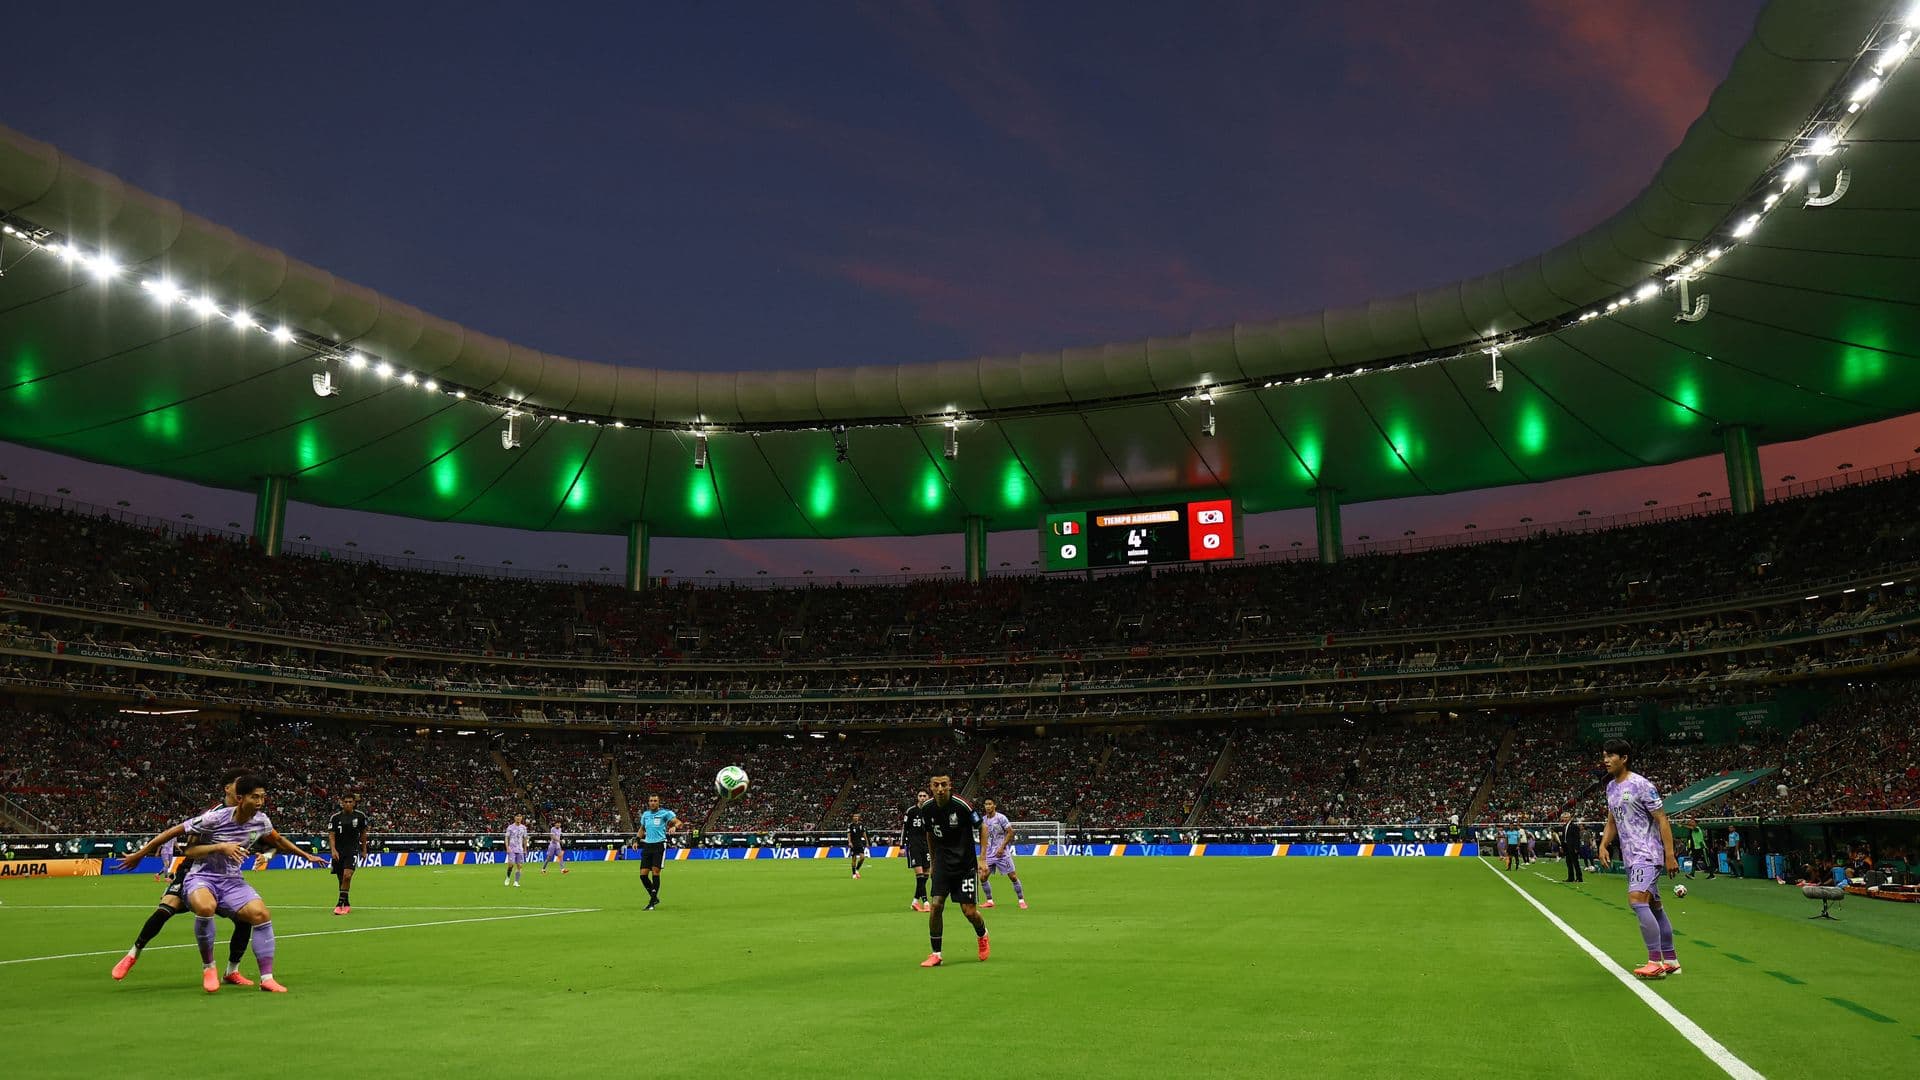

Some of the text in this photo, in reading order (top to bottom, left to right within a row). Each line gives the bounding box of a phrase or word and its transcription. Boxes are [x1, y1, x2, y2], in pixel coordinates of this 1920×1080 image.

[1103, 516, 1131, 525] TIEMPO
[1127, 528, 1147, 548] 4'
[1816, 619, 1887, 635] GUADALAJARA
[80, 650, 149, 663] GUADALAJARA
[1396, 665, 1460, 673] GUADALAJARA
[444, 686, 502, 694] GUADALAJARA
[337, 825, 343, 834] 7
[702, 849, 730, 859] VISA
[771, 847, 800, 858] VISA
[841, 847, 871, 858] VA
[1062, 845, 1094, 856] VISA
[1304, 844, 1339, 856] VISA
[1389, 844, 1426, 857] VISA
[282, 854, 313, 869] VISA
[357, 853, 382, 867] VISA
[418, 852, 442, 865] VISA
[474, 851, 495, 864] VISA
[525, 851, 544, 863] VISA
[0, 863, 48, 876] AJARA
[961, 878, 975, 892] 25
